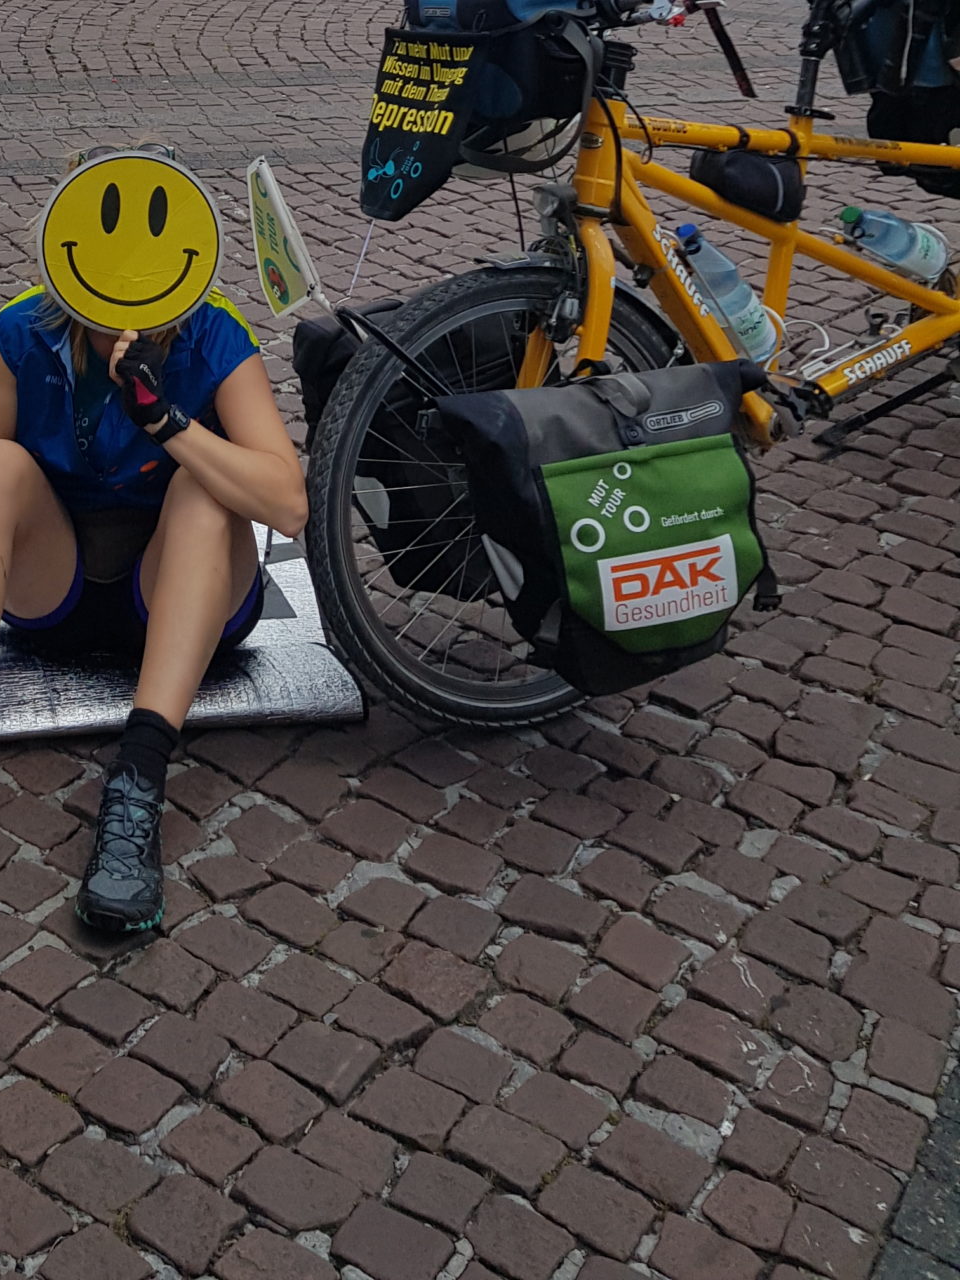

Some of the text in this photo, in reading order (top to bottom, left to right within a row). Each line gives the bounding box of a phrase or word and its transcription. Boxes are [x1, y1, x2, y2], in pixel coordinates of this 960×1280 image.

[381, 55, 419, 78] Wissen
[429, 41, 452, 60] Mut
[381, 77, 404, 96] mit
[401, 80, 427, 100] dem
[254, 201, 266, 240] MUT
[266, 211, 280, 256] TOUR
[652, 223, 711, 318] SCHAUFF
[843, 338, 913, 386] SCHAUFF
[647, 413, 685, 429] ORTLIEB
[587, 478, 611, 508] MUT
[600, 487, 626, 520] TOUR
[660, 510, 699, 528] Gefördert
[609, 544, 726, 603] DAK
[614, 584, 729, 626] Gesundheit
